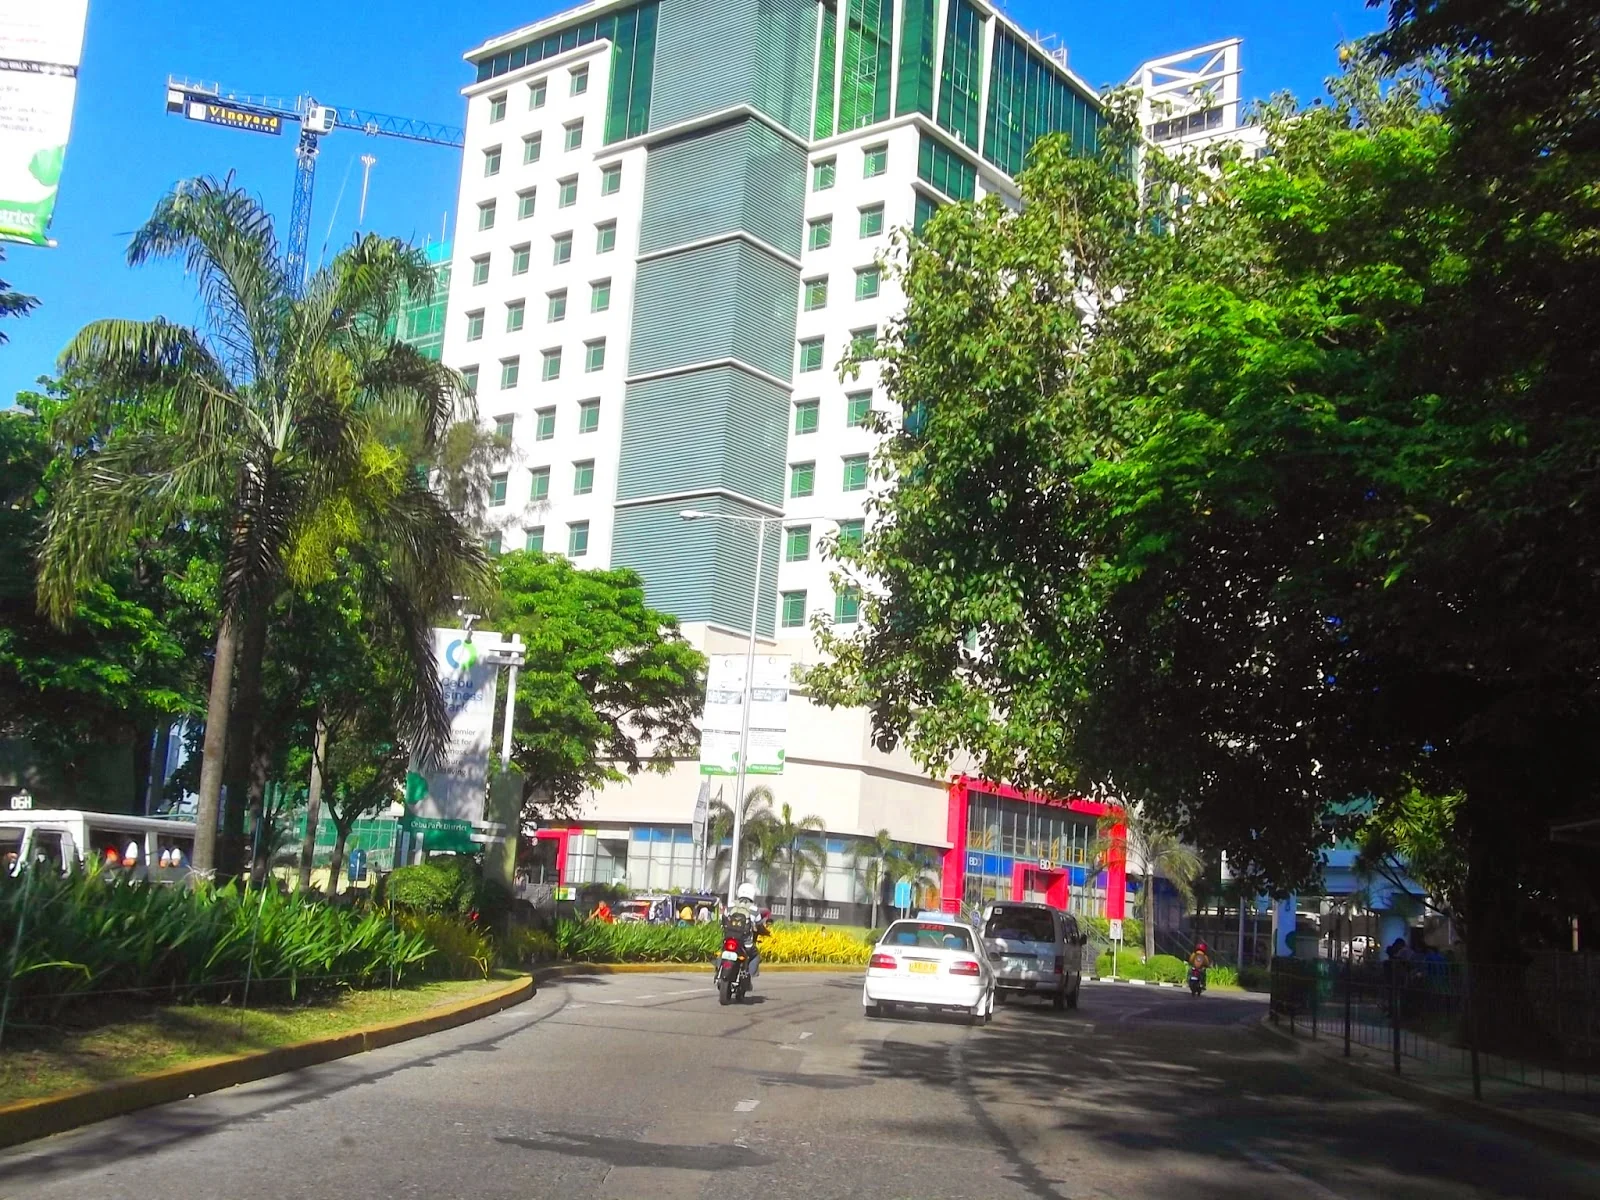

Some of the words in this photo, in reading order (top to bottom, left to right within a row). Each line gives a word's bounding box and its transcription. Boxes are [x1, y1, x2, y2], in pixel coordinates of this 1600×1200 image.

[209, 105, 278, 127] Vineyard
[210, 116, 275, 132] CONSTRUCTION
[442, 677, 473, 688] Cebu
[443, 690, 483, 701] siness
[451, 728, 476, 736] remier
[411, 821, 427, 829] Cebu
[428, 822, 442, 830] Park
[443, 823, 467, 831] District
[968, 856, 982, 867] BDO
[1039, 858, 1056, 871] BDO
